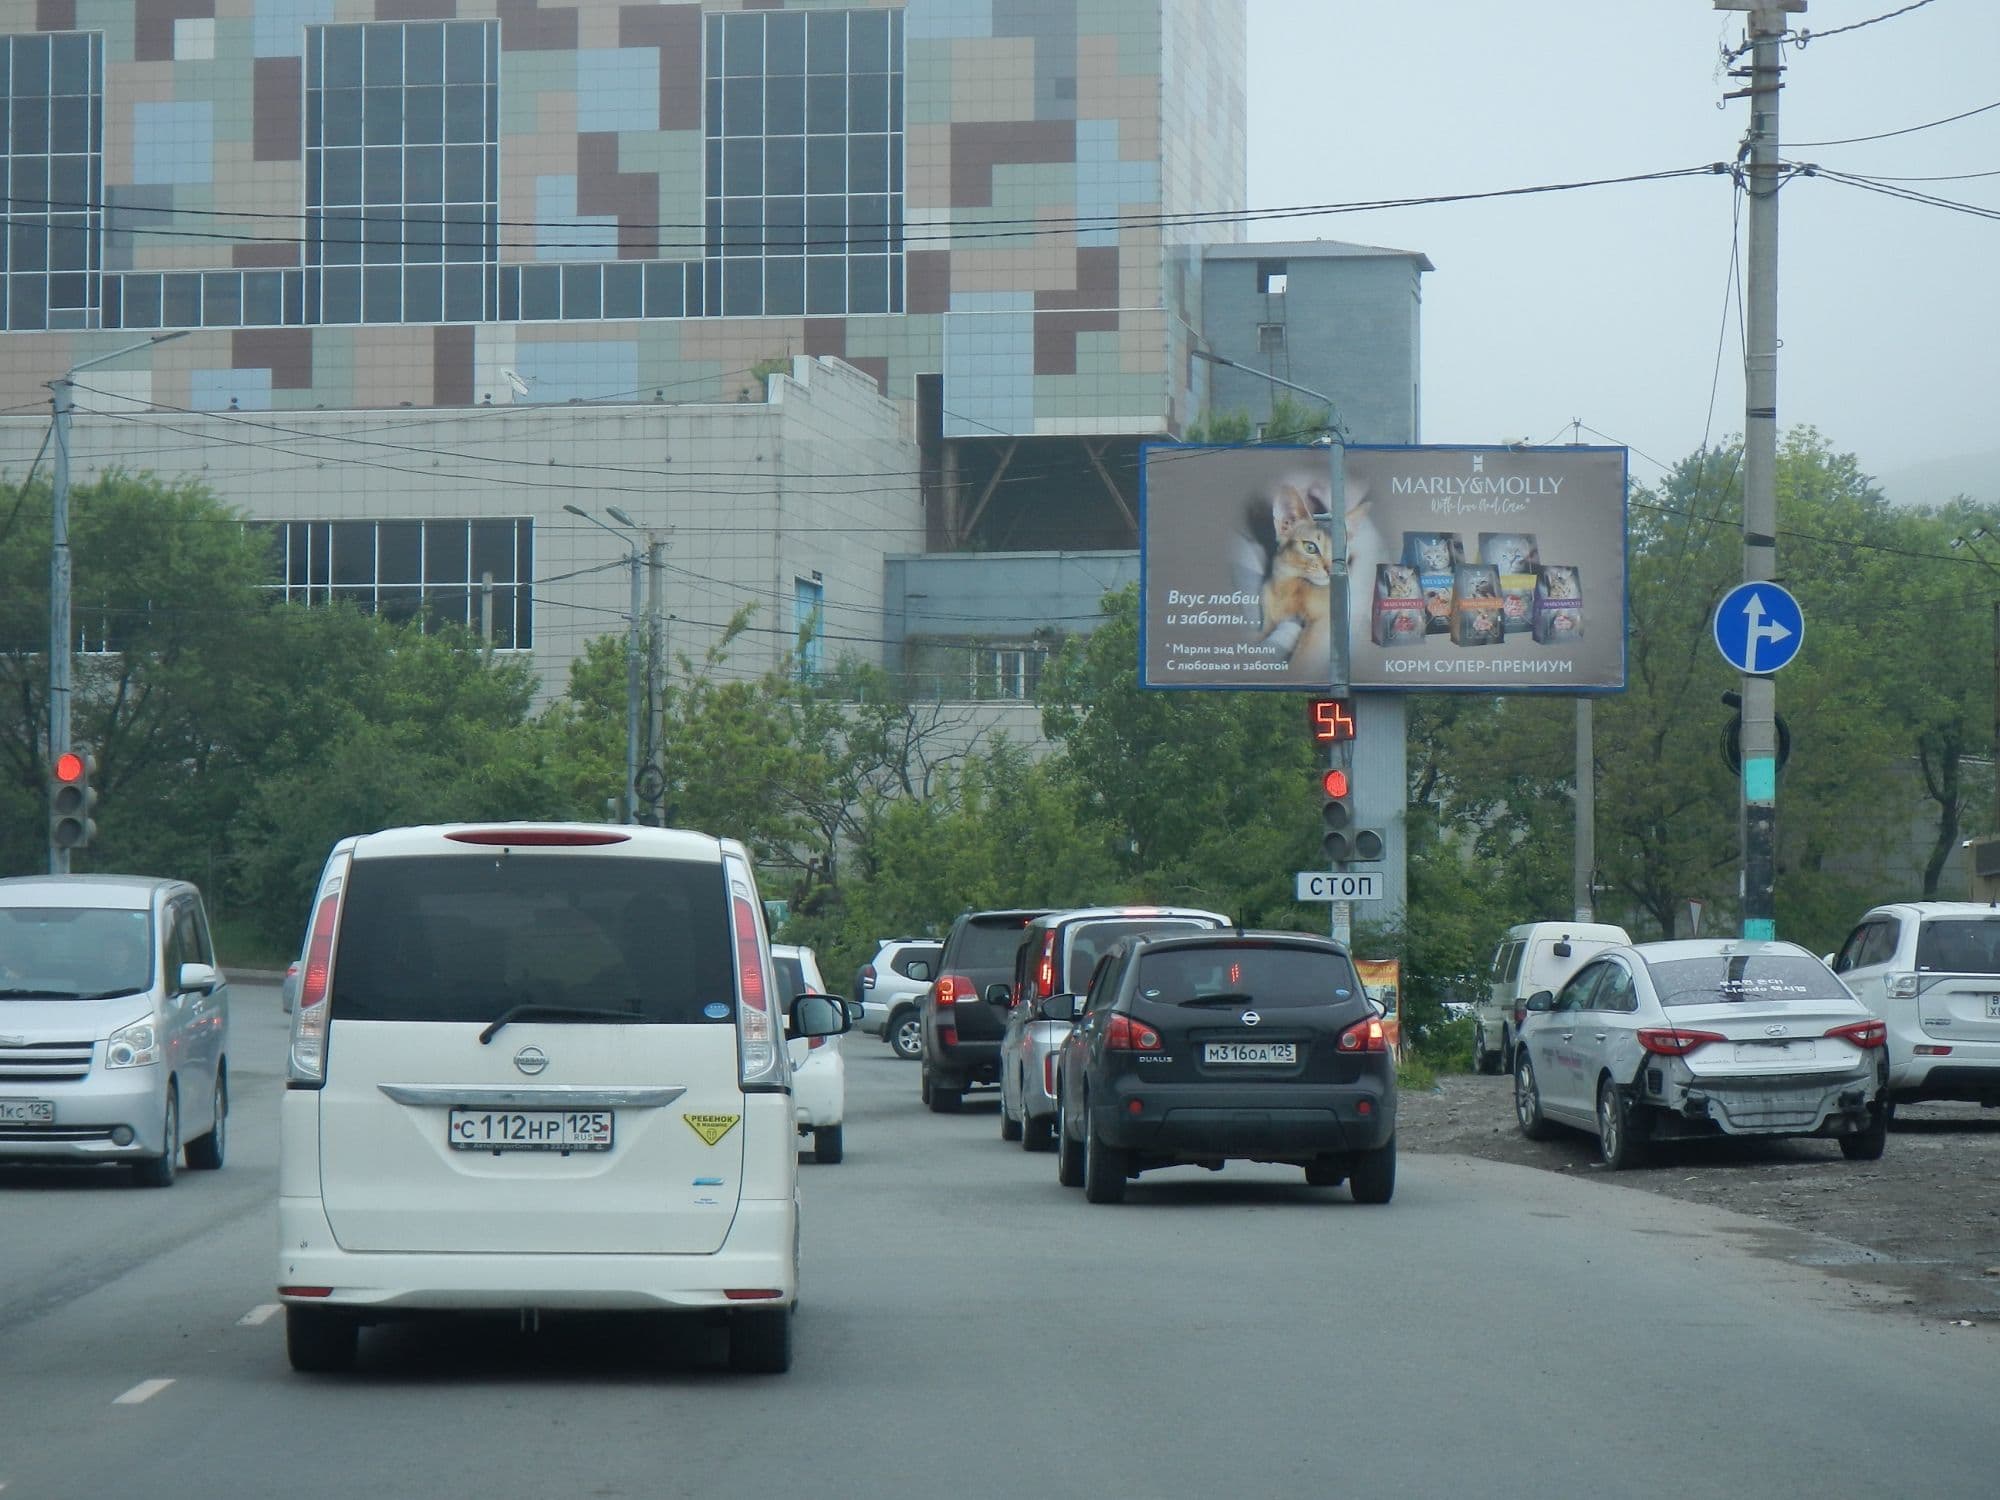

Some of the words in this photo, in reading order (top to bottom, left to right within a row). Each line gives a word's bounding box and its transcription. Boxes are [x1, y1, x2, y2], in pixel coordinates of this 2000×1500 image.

[1391, 476, 1564, 495] MARLY&MOLLY
[1168, 590, 1205, 607] Вкус
[1208, 590, 1260, 604] любви
[1167, 614, 1176, 624] и
[1173, 643, 1211, 656] Марли
[1213, 645, 1235, 655] энд
[1237, 643, 1276, 655] Молли
[1167, 660, 1176, 671] С
[1178, 660, 1231, 671] любовью
[1233, 662, 1241, 671] и
[1243, 660, 1289, 671] заботой
[1385, 660, 1430, 673] КОРМ
[1434, 660, 1572, 673] СУПЕР-ПРЕМИУМ
[1316, 702, 1354, 738] 54
[1310, 876, 1371, 896] СТОП
[1270, 1045, 1292, 1057] 125
[28, 1104, 49, 1115] 125
[567, 1114, 604, 1133] 125
[691, 1115, 733, 1123] РЕБЕНОК
